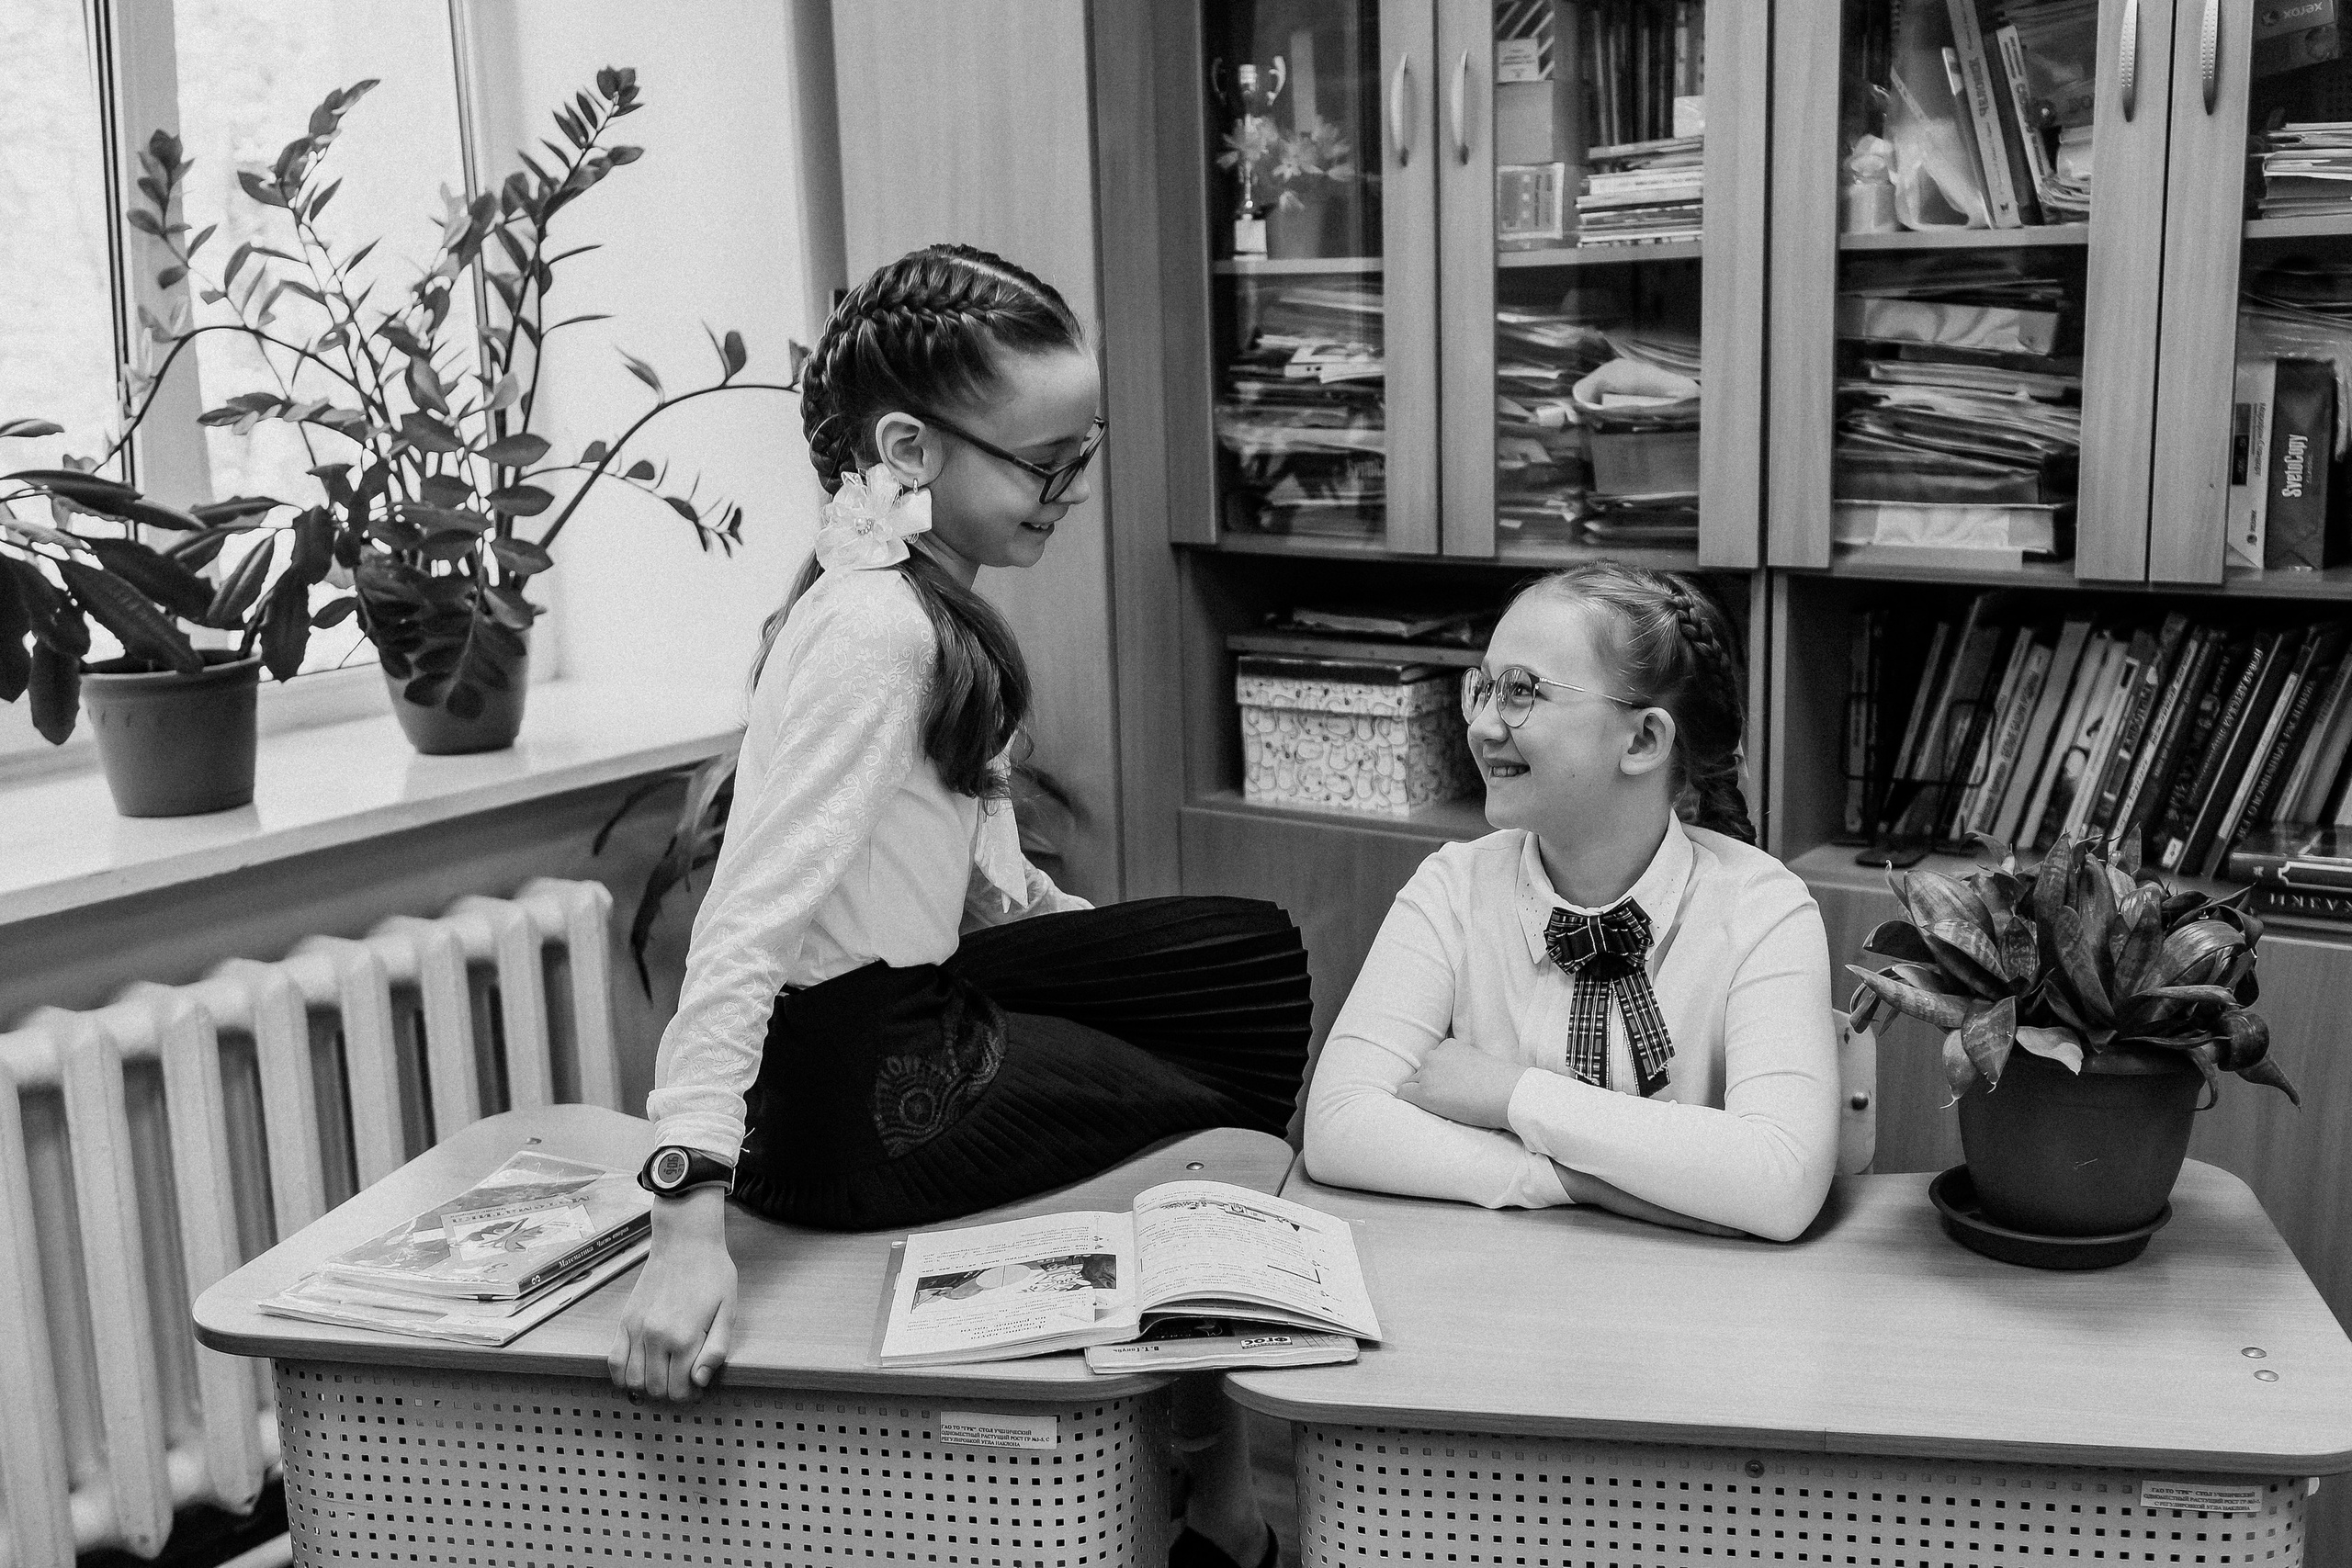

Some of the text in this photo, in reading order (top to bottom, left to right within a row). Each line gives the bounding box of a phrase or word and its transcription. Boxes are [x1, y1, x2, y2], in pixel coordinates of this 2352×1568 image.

[2283, 2, 2323, 18] xerox
[2281, 434, 2309, 498] SvetoCopy
[558, 1244, 594, 1269] Математика
[595, 1235, 611, 1247] Часть
[611, 1225, 630, 1239] вторая
[1244, 1337, 1287, 1345] ФГОС
[941, 1429, 979, 1438] ОДНОМЕСТНЫЙ
